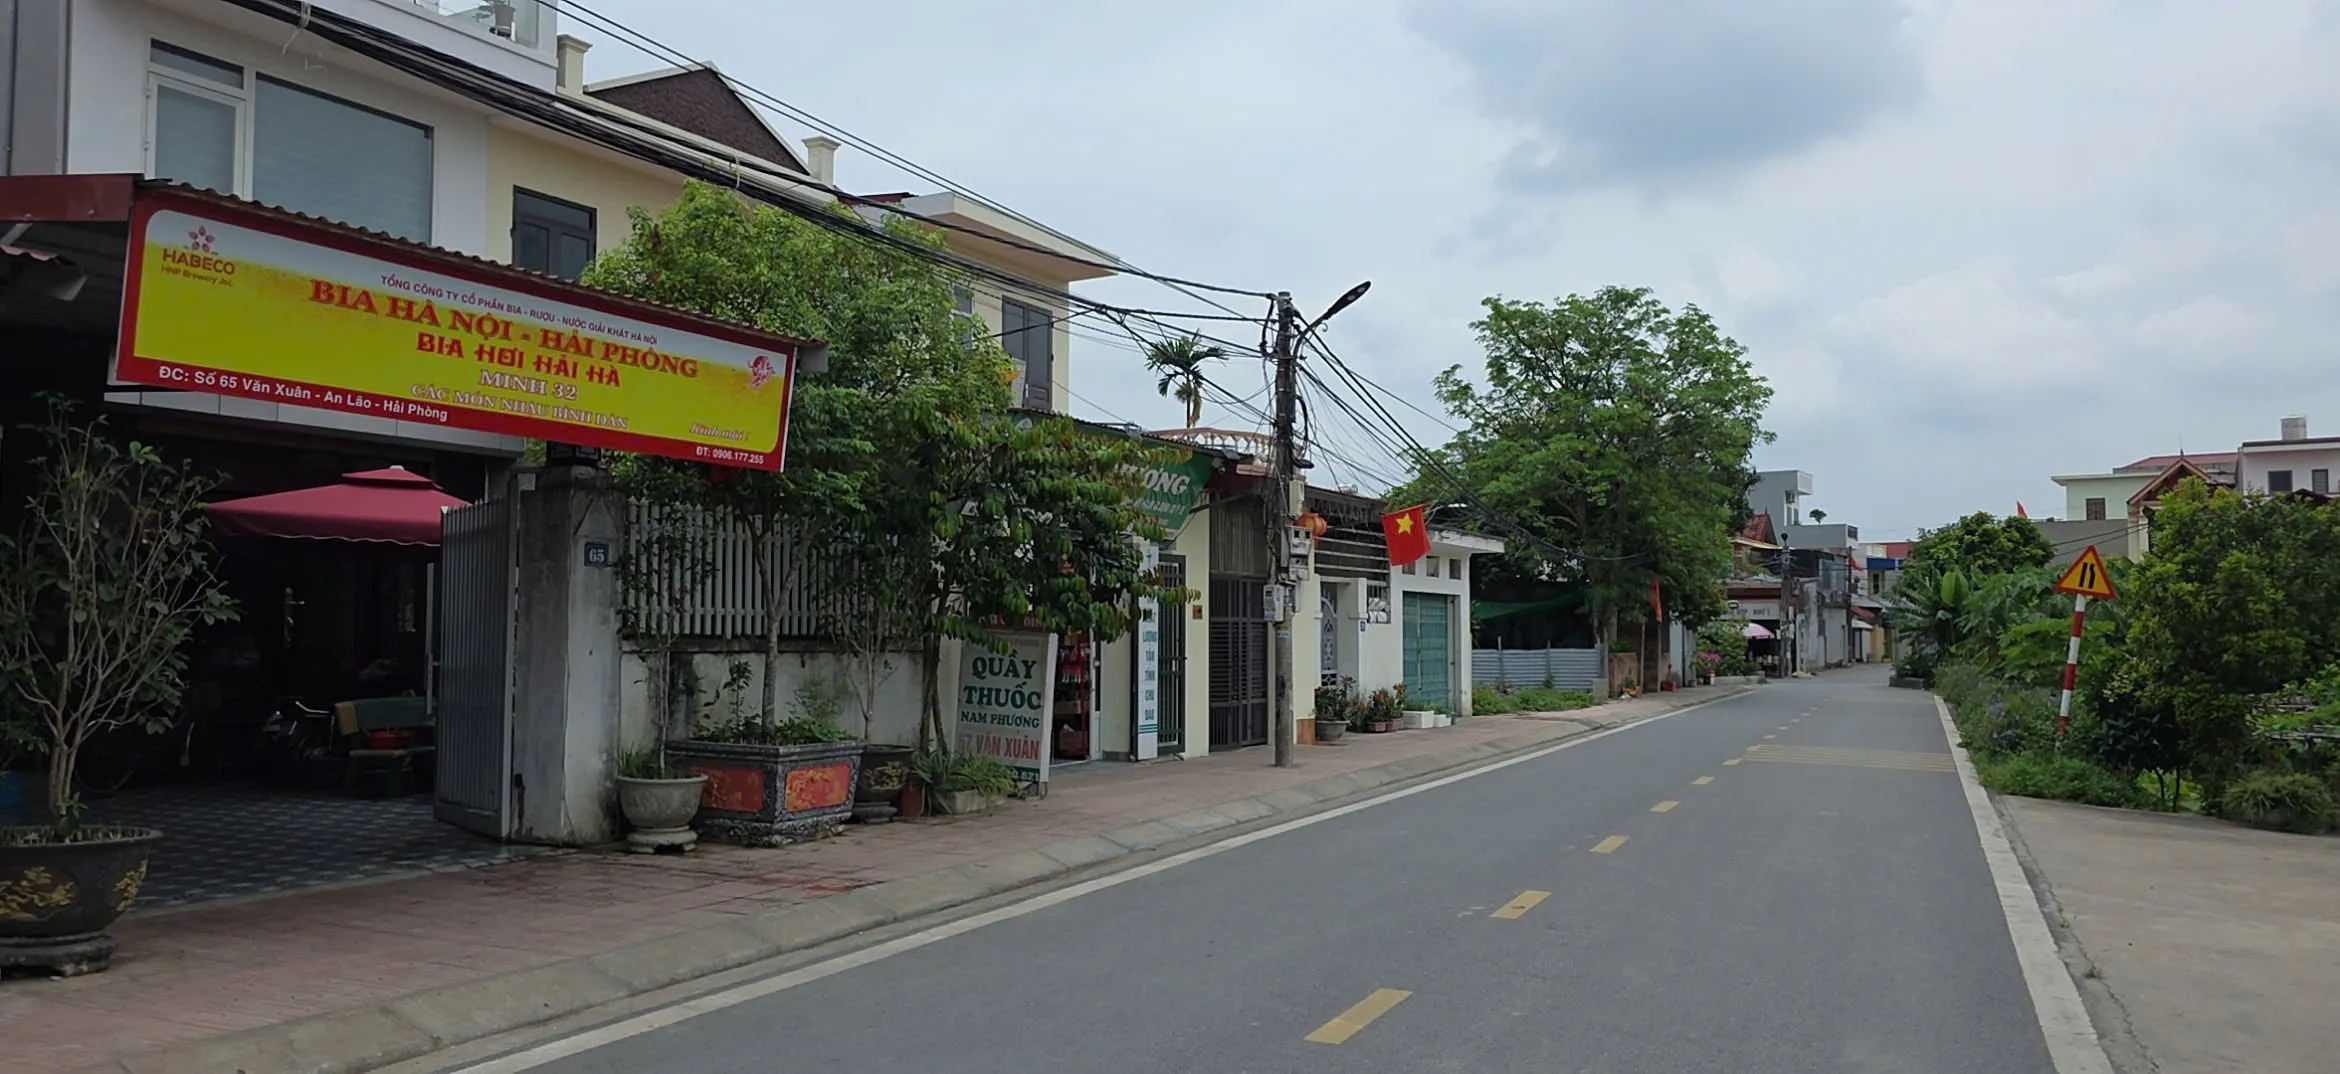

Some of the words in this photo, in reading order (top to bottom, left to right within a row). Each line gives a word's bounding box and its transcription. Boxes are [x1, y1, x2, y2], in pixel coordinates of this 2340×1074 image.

[163, 248, 235, 275] HABECO
[381, 273, 410, 290] TỔNG
[413, 283, 443, 298] CÔNG
[446, 290, 459, 301] TY
[461, 291, 476, 305] CỔ
[478, 297, 504, 311] PHẦN
[506, 304, 522, 315] BIA
[530, 308, 555, 322] RƯỢU
[562, 316, 587, 329] NƯỚC
[588, 321, 606, 333] GIẢI
[607, 326, 629, 339] KHÁT
[631, 332, 641, 342] HÀ
[644, 335, 657, 345] NỘI
[309, 279, 378, 316] BIA
[386, 298, 441, 327] HÀ
[448, 309, 513, 341] NỘI
[539, 329, 594, 358] HẢI
[601, 341, 699, 378] PHÒNG
[416, 331, 465, 359] BIA
[474, 343, 524, 369] HƠI
[533, 353, 578, 380] HẢI
[586, 363, 621, 387] HÀ
[159, 365, 189, 382] ĐC:
[194, 371, 217, 386] Số
[220, 376, 237, 389] 65
[242, 378, 271, 394] Văn
[275, 383, 311, 400] Xuân
[324, 391, 342, 404] An
[347, 394, 372, 408] Lão
[383, 399, 404, 413] Hải
[407, 403, 448, 422] Phòng
[479, 368, 547, 396] MINH
[552, 382, 578, 401] 32
[410, 383, 450, 401] CÁC
[453, 390, 497, 409] MÓN
[553, 403, 592, 424] BÌNH
[595, 412, 629, 429] DÂN
[696, 446, 711, 457] ĐT:
[589, 548, 605, 564] 65
[972, 649, 1037, 680] QUẦY
[963, 681, 1042, 710] THUỐC
[960, 710, 987, 724] NAM
[990, 713, 1040, 729] PHƯƠNG
[977, 731, 1002, 757] VĂN
[1004, 735, 1039, 760] XUÂN
